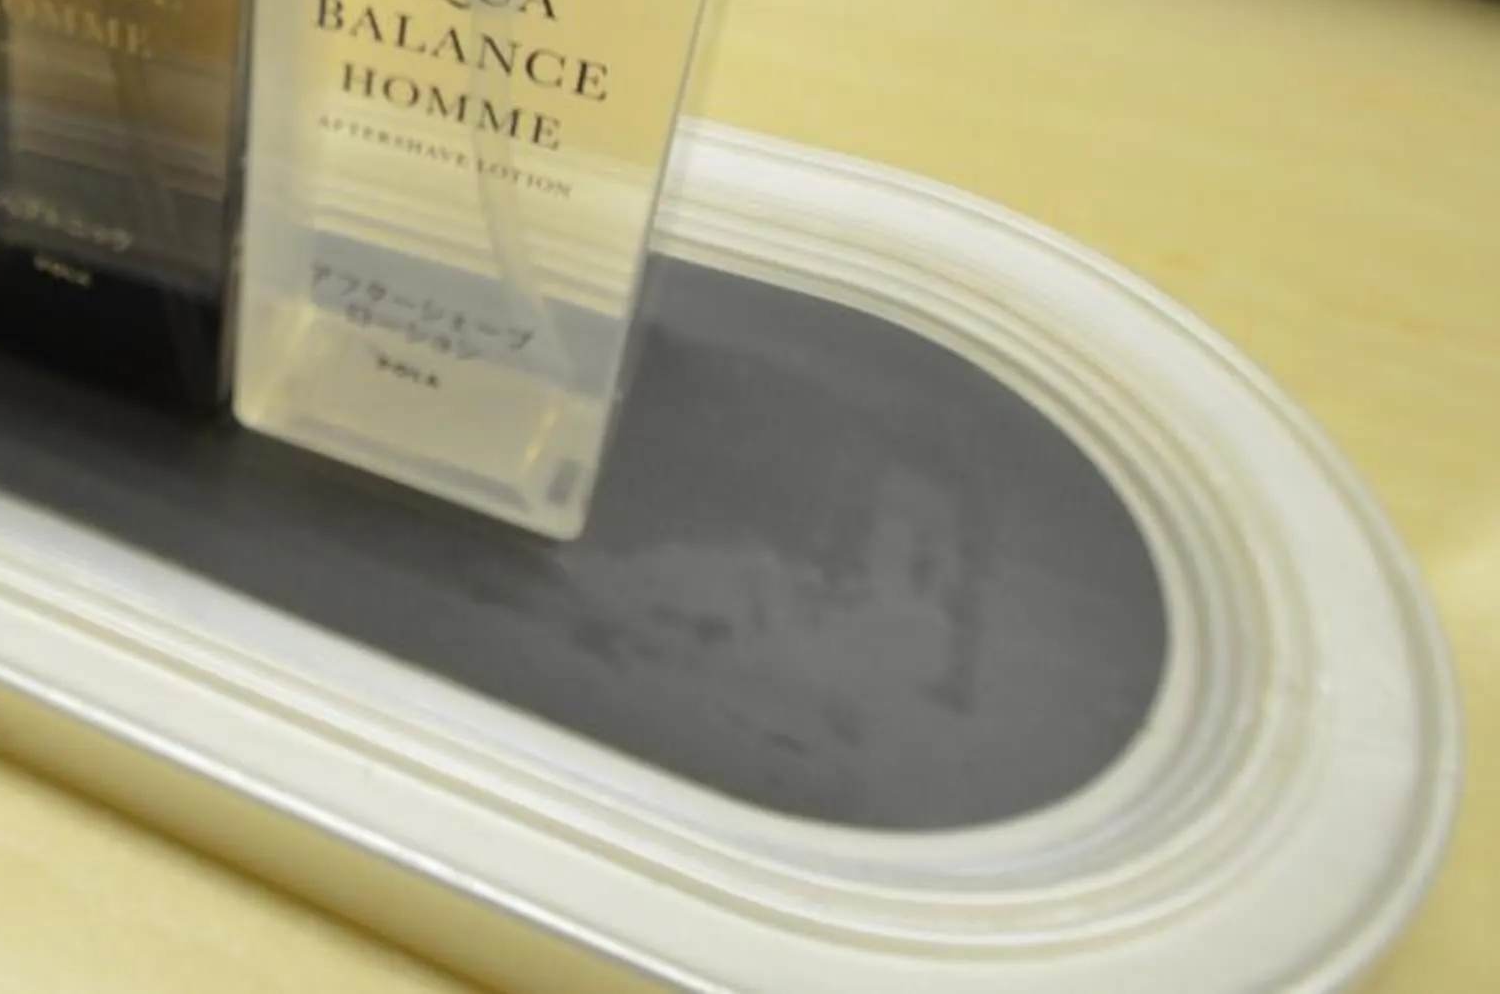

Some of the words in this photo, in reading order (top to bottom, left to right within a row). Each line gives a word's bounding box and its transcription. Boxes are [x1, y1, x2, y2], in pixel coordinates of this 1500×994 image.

[342, 63, 561, 152] HOMME
[318, 115, 469, 169] AFTERSHAVE
[477, 159, 572, 199] LOTION
